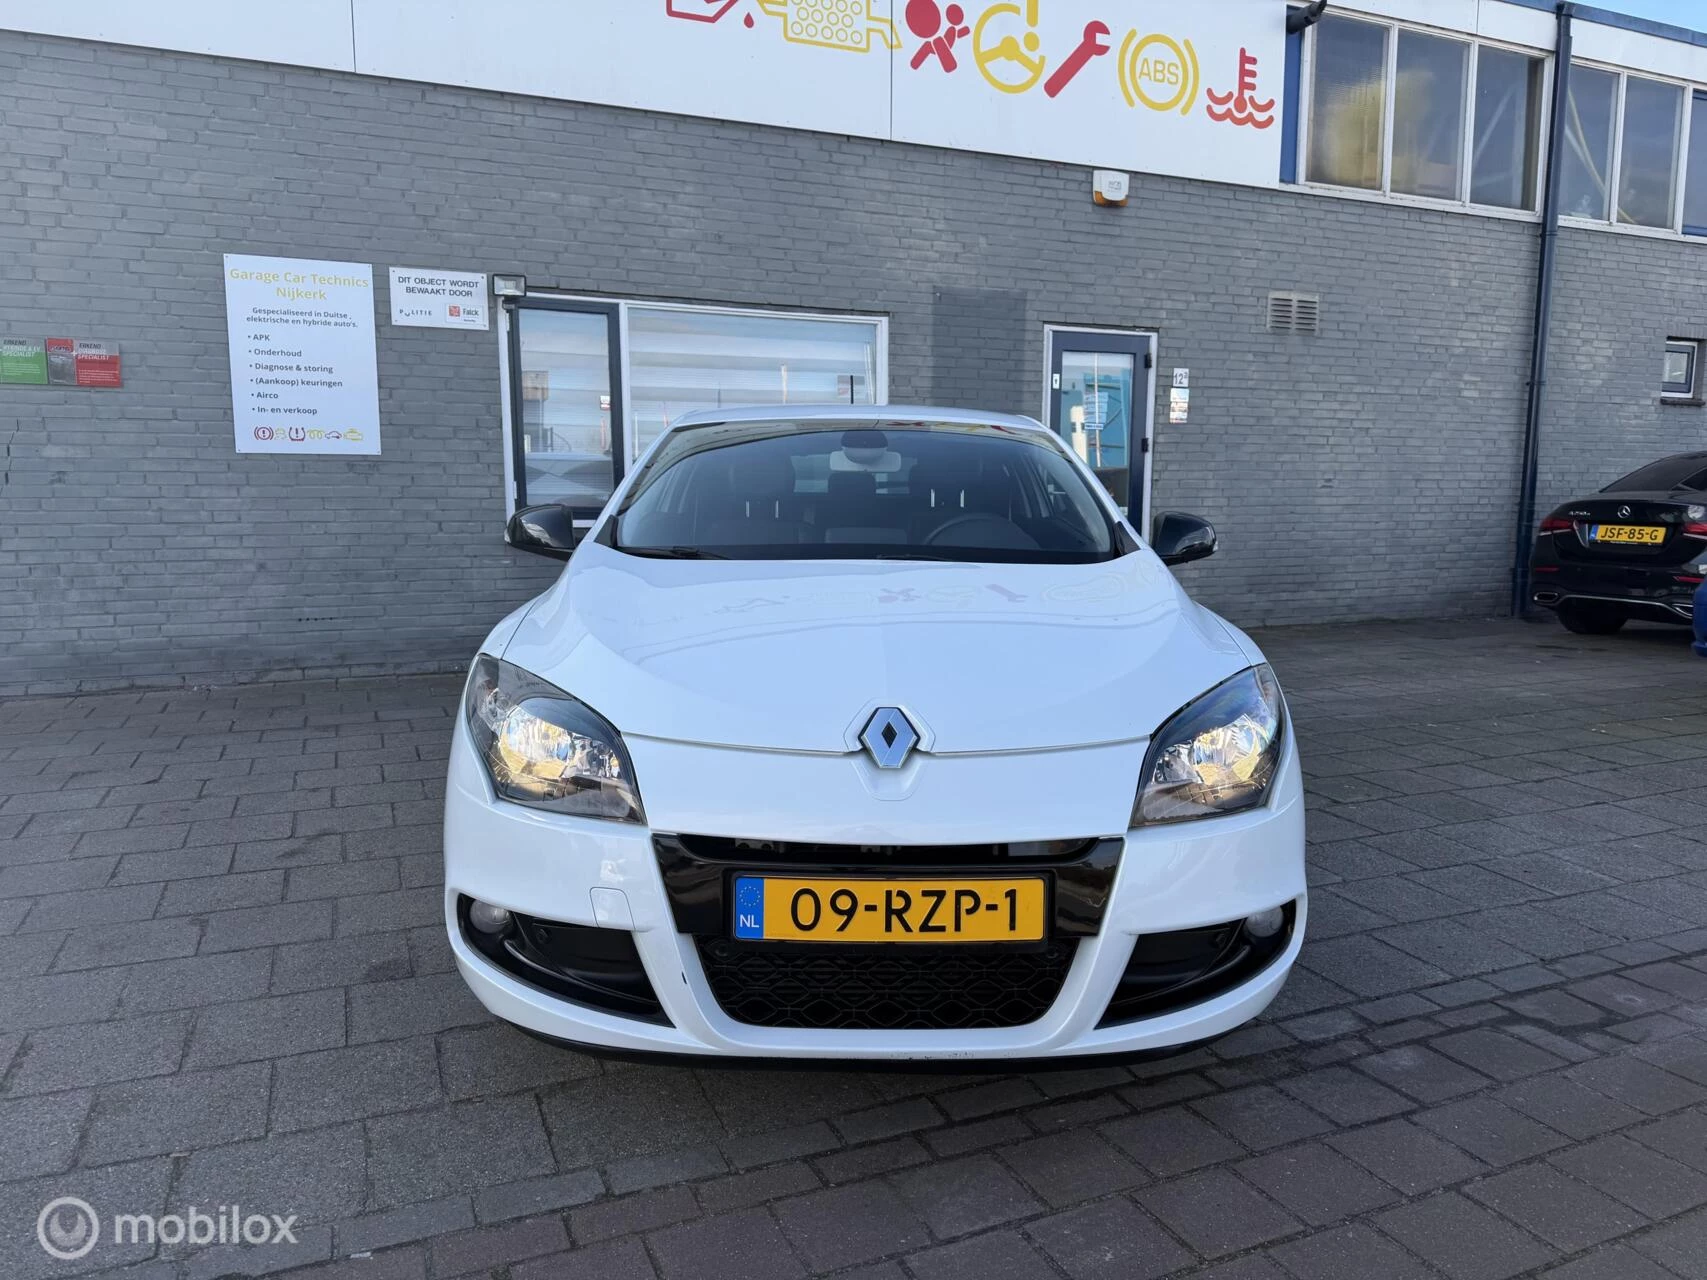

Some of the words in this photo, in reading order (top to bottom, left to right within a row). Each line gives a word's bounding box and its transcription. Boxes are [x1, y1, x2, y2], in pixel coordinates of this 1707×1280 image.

[1139, 58, 1179, 85] ABS
[230, 268, 279, 283] Garage
[284, 272, 306, 283] Car
[310, 273, 369, 288] Technics
[398, 276, 411, 284] DIT
[414, 277, 446, 286] OBJECT
[449, 280, 479, 288] WORDT
[276, 287, 327, 301] Nijkerk
[406, 286, 446, 295] BEWAAKT
[252, 307, 312, 317] Gespecialiseerd
[246, 316, 290, 324] elektrische
[303, 318, 332, 328] hybride
[254, 349, 302, 357] Onderhoud
[255, 363, 294, 372] Diagnose
[304, 365, 334, 374] storing
[255, 378, 299, 387] (Aankoop)
[300, 379, 343, 389] keuringen
[283, 406, 318, 416] verkoop
[1601, 527, 1659, 541] JSF-85-G
[739, 914, 760, 929] NL
[790, 887, 1017, 934] 09-RZP-1
